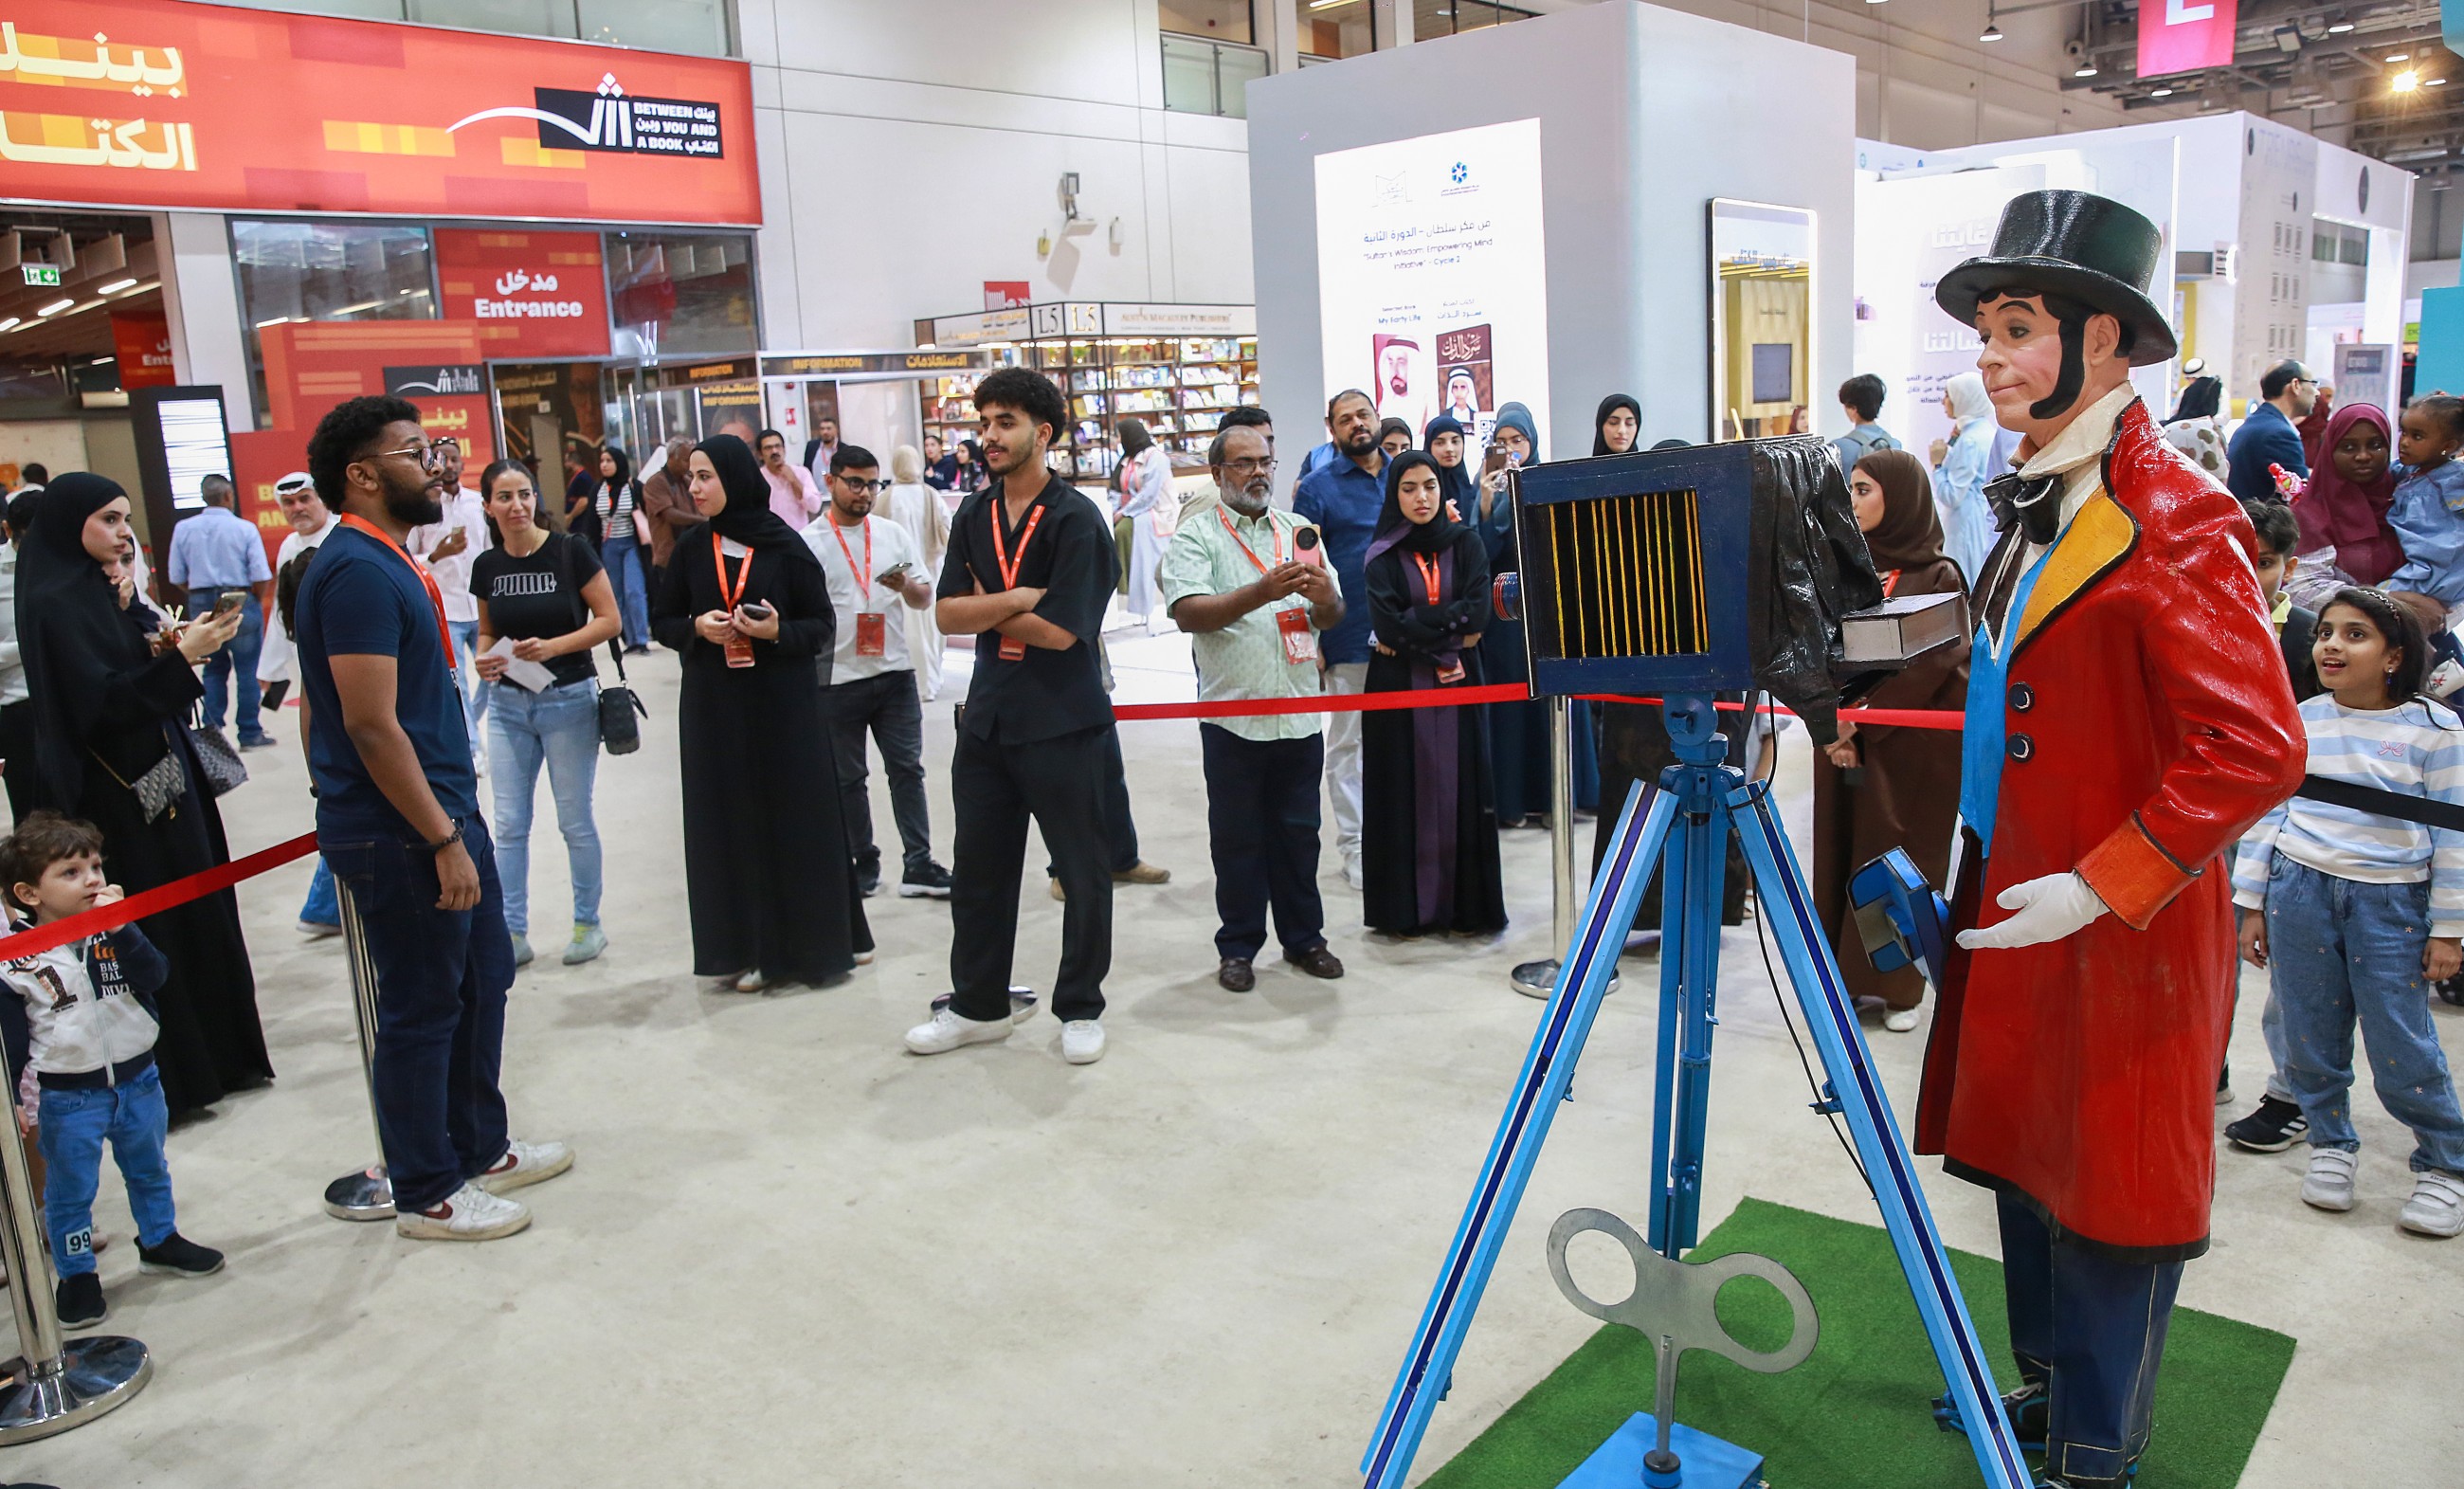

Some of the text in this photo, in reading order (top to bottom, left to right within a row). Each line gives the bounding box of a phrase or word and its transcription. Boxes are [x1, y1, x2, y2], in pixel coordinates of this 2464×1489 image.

[633, 101, 694, 118] BETWEEN
[661, 120, 717, 136] YOU AND
[636, 136, 684, 151] A BOOK
[684, 139, 719, 154] الكتاب
[1390, 227, 1417, 242] الدورة
[1474, 238, 1494, 247] Mind
[1433, 256, 1456, 267] Cycle
[496, 268, 559, 296] مدخل
[474, 299, 584, 318] Entrance
[1038, 307, 1060, 334] L5
[1071, 305, 1097, 332] L5
[1924, 331, 1985, 353] سالتنا
[689, 363, 734, 379] INFORMATION
[792, 357, 863, 371] INFORMATION
[492, 572, 557, 597] PUMA
[69, 1231, 91, 1252] 99
